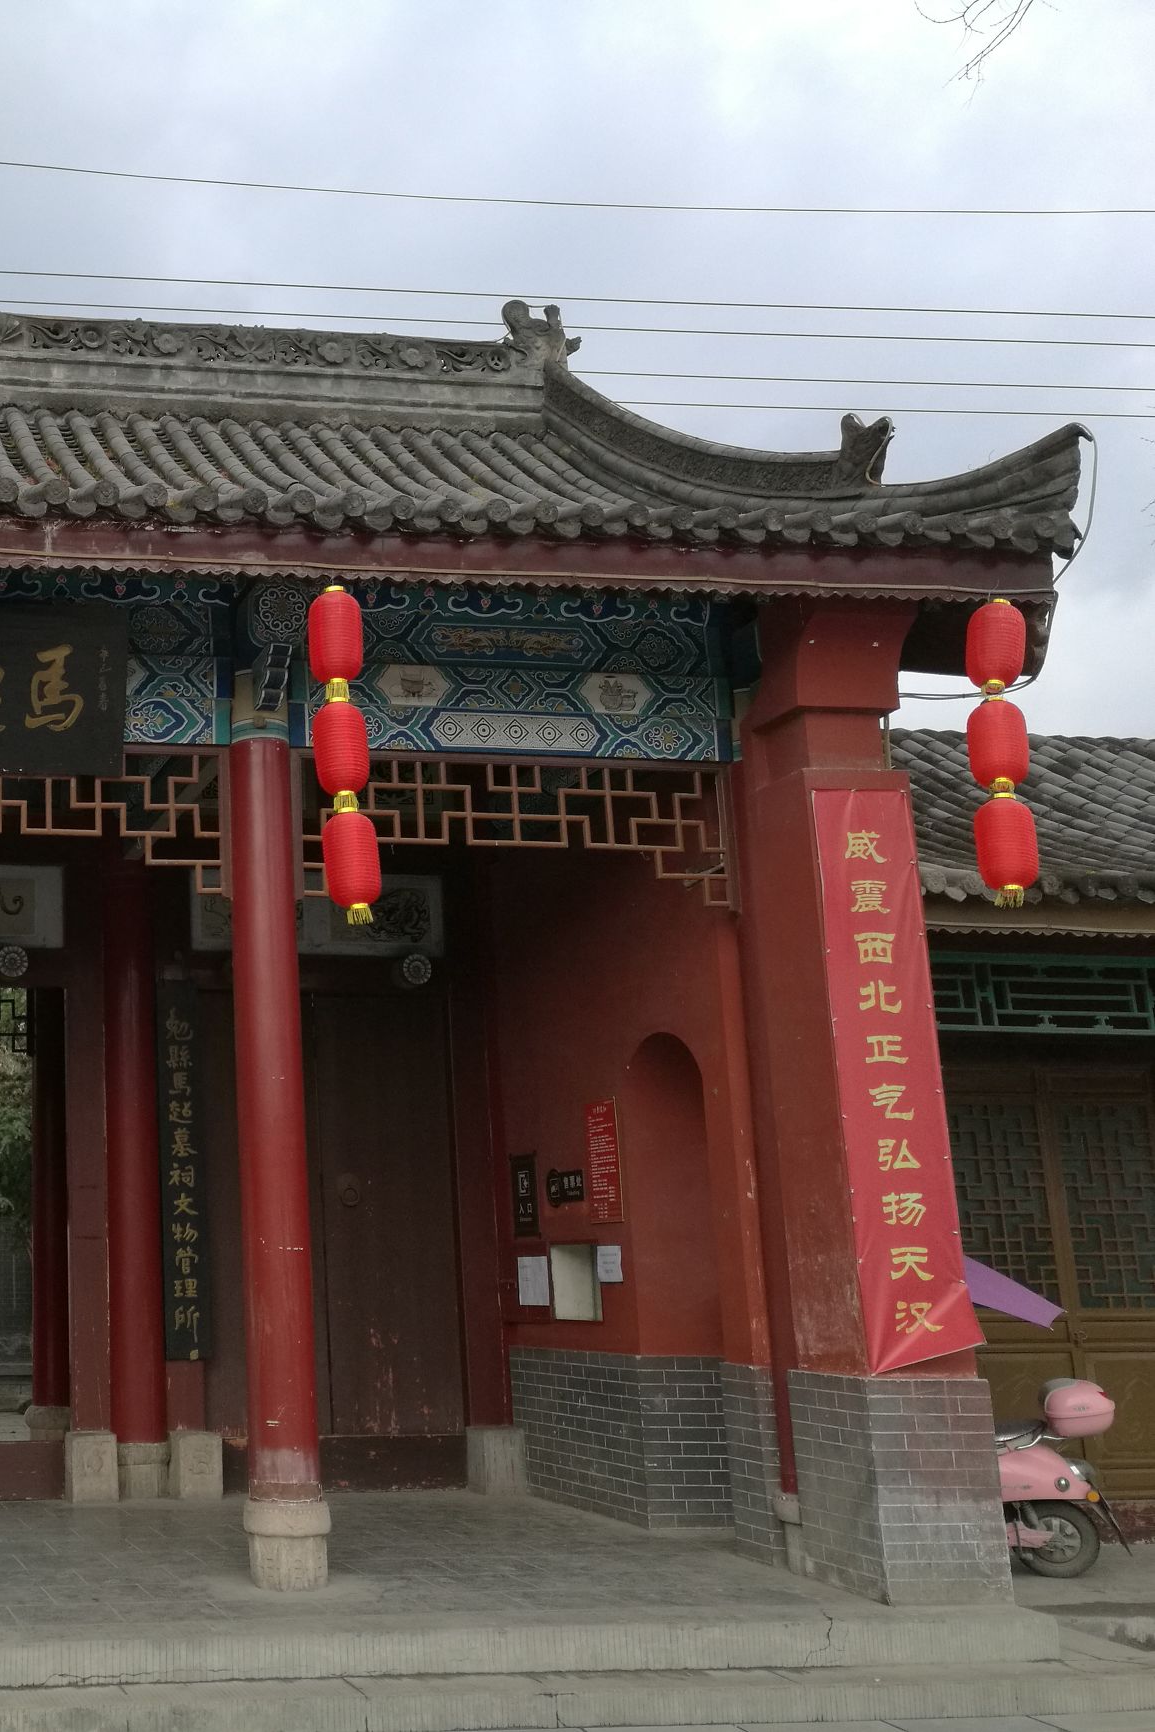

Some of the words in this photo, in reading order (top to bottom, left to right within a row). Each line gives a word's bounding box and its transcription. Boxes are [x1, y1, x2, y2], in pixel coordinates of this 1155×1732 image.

[844, 830, 944, 1335] 威震西北正气弘扬天汉
[165, 1007, 201, 1343] 勉縣馬超墓祠文物管理所
[519, 1203, 533, 1214] 入口
[563, 1175, 583, 1190] 售票处
